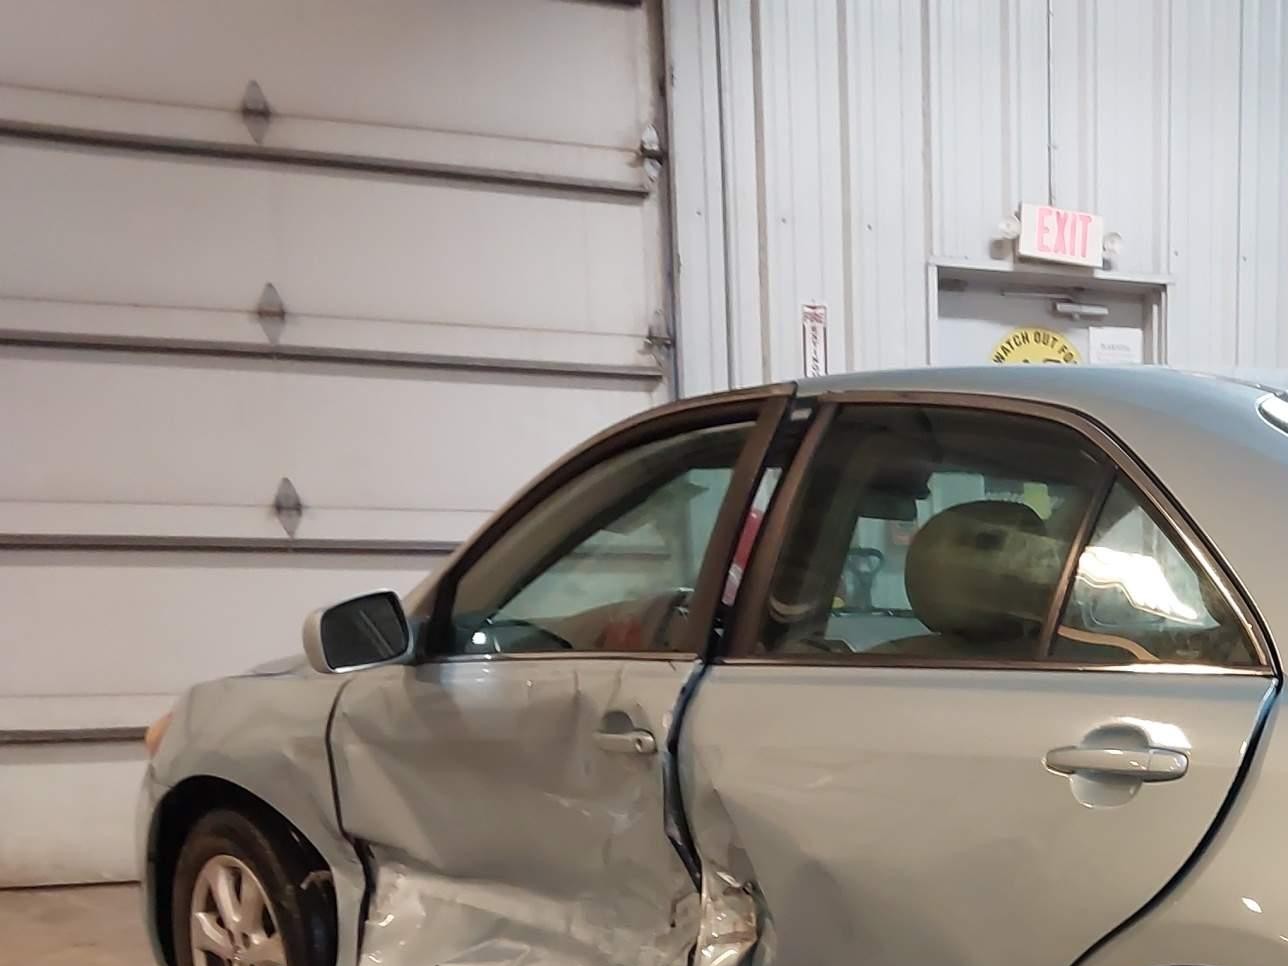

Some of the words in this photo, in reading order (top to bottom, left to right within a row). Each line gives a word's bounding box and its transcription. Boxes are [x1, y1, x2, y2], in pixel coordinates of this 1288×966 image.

[1036, 207, 1092, 258] EXIT
[992, 331, 1030, 363] WATCH
[1033, 331, 1058, 349] OUT
[1057, 344, 1078, 364] FO
